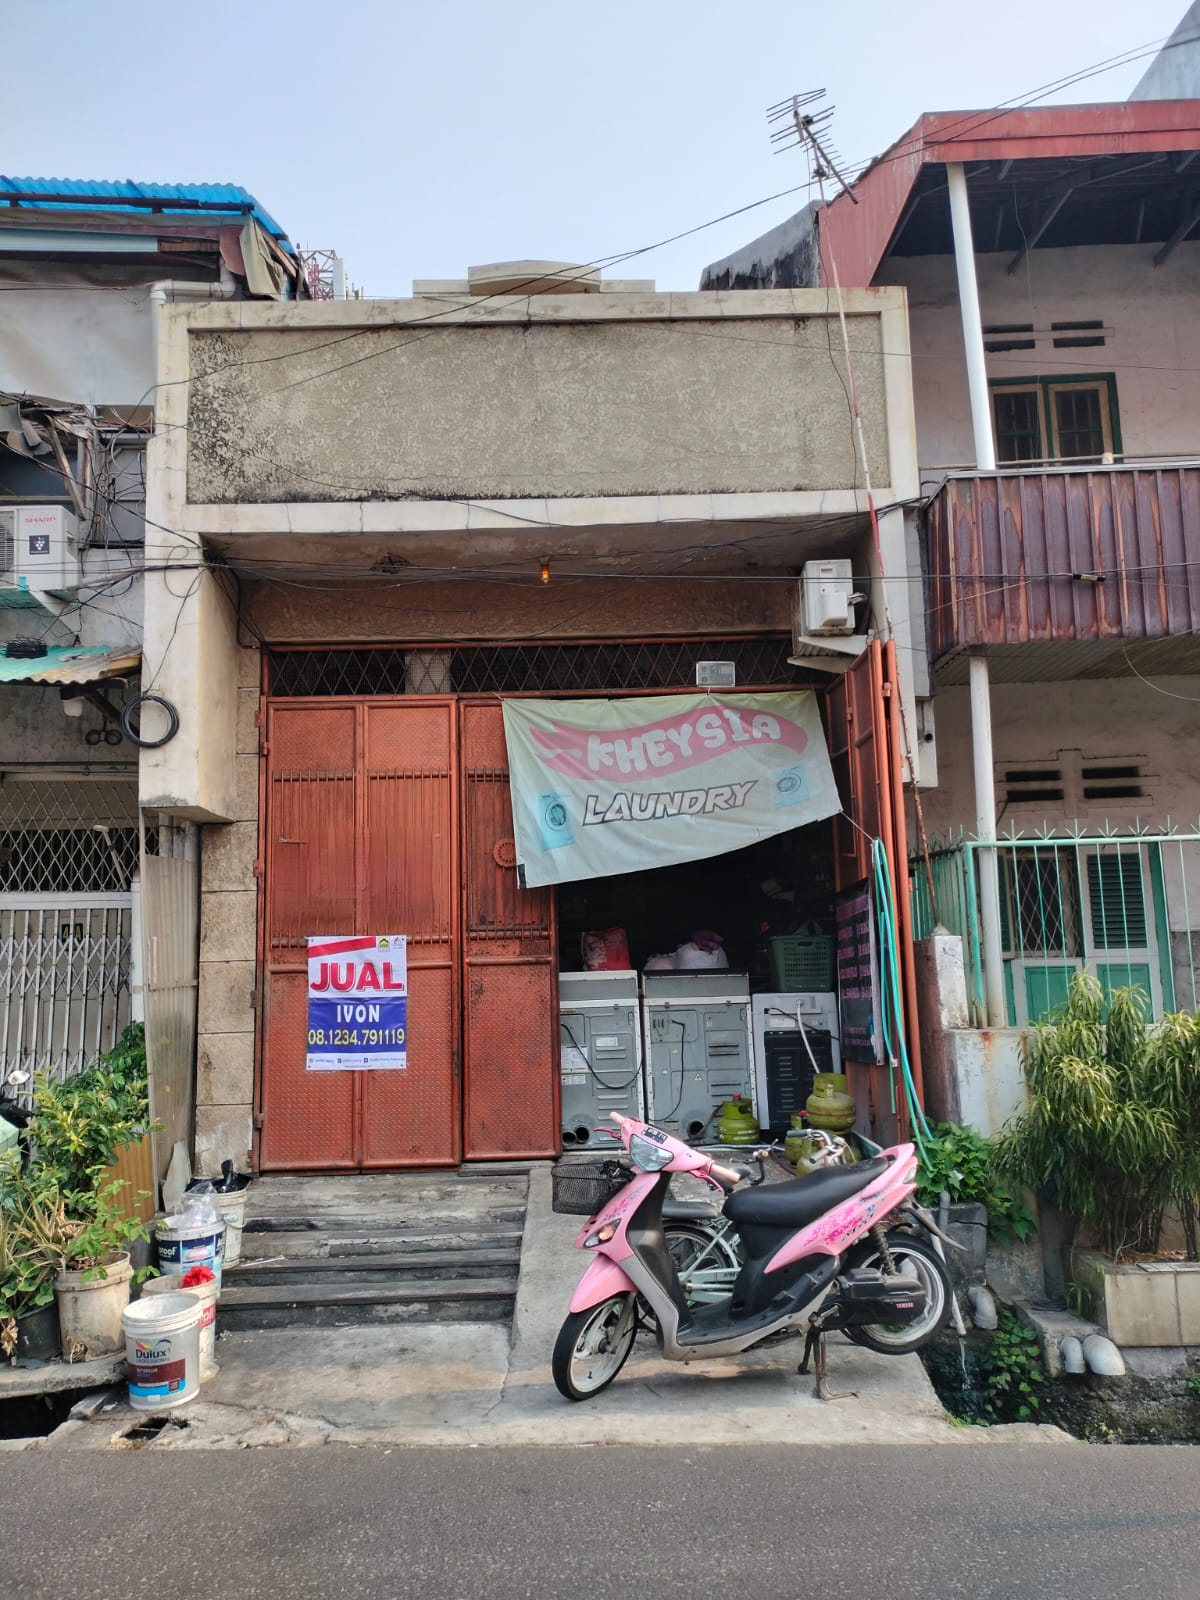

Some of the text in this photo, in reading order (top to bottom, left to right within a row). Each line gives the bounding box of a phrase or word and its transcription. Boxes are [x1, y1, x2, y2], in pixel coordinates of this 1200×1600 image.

[24, 516, 56, 524] SHARP
[587, 709, 780, 773] KHEYSIA
[582, 779, 759, 827] LAUNDRY
[310, 962, 404, 992] JUAL
[337, 1005, 380, 1022] IVON
[308, 1028, 405, 1046] 08.1234.791119
[136, 1349, 167, 1359] Dulux
